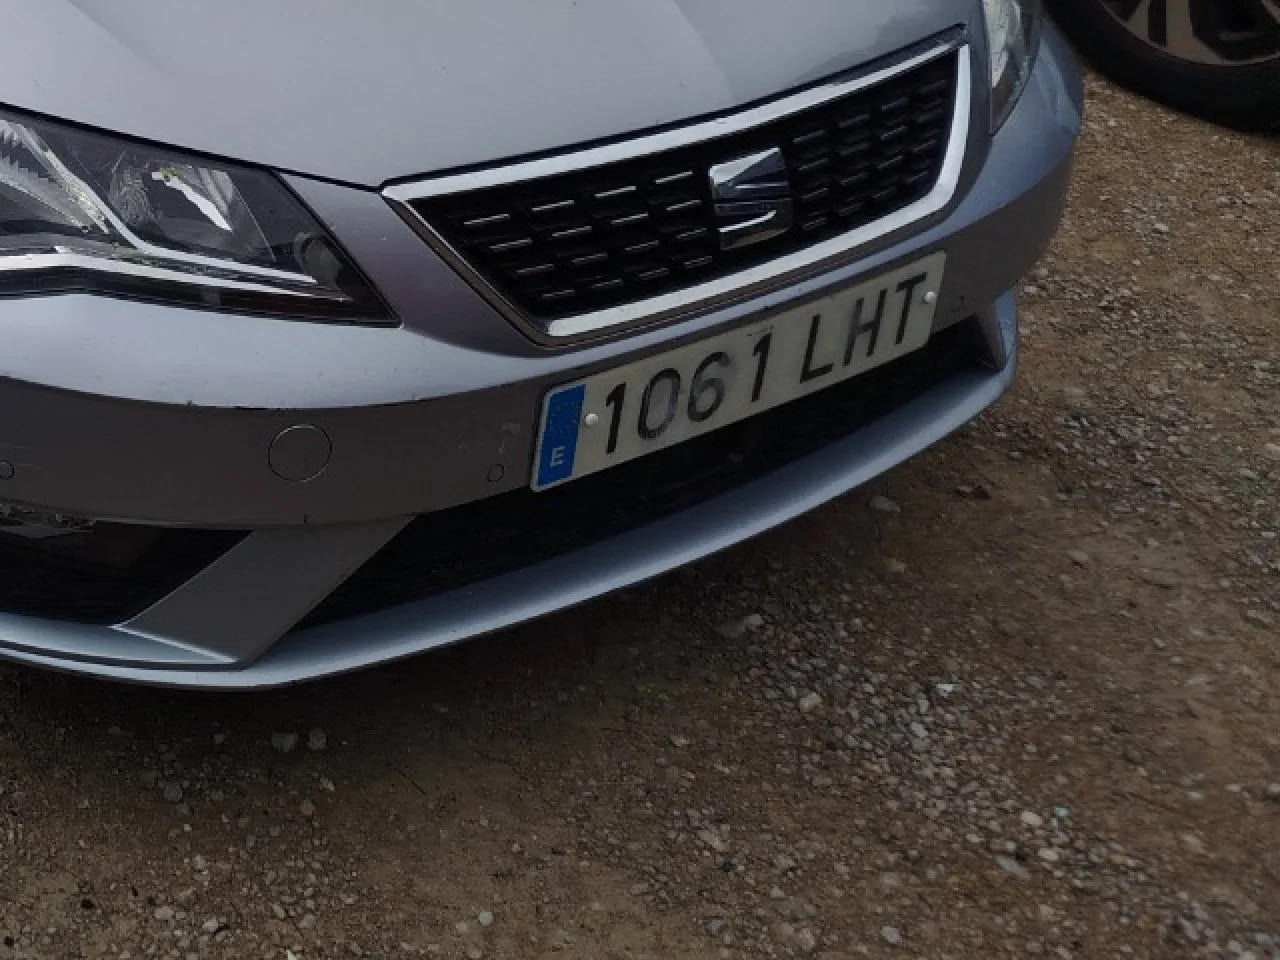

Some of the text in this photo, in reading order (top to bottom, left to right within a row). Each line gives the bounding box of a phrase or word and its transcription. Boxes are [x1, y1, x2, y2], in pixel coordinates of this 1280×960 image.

[604, 271, 928, 454] 1061 LHT
[549, 445, 566, 467] E
